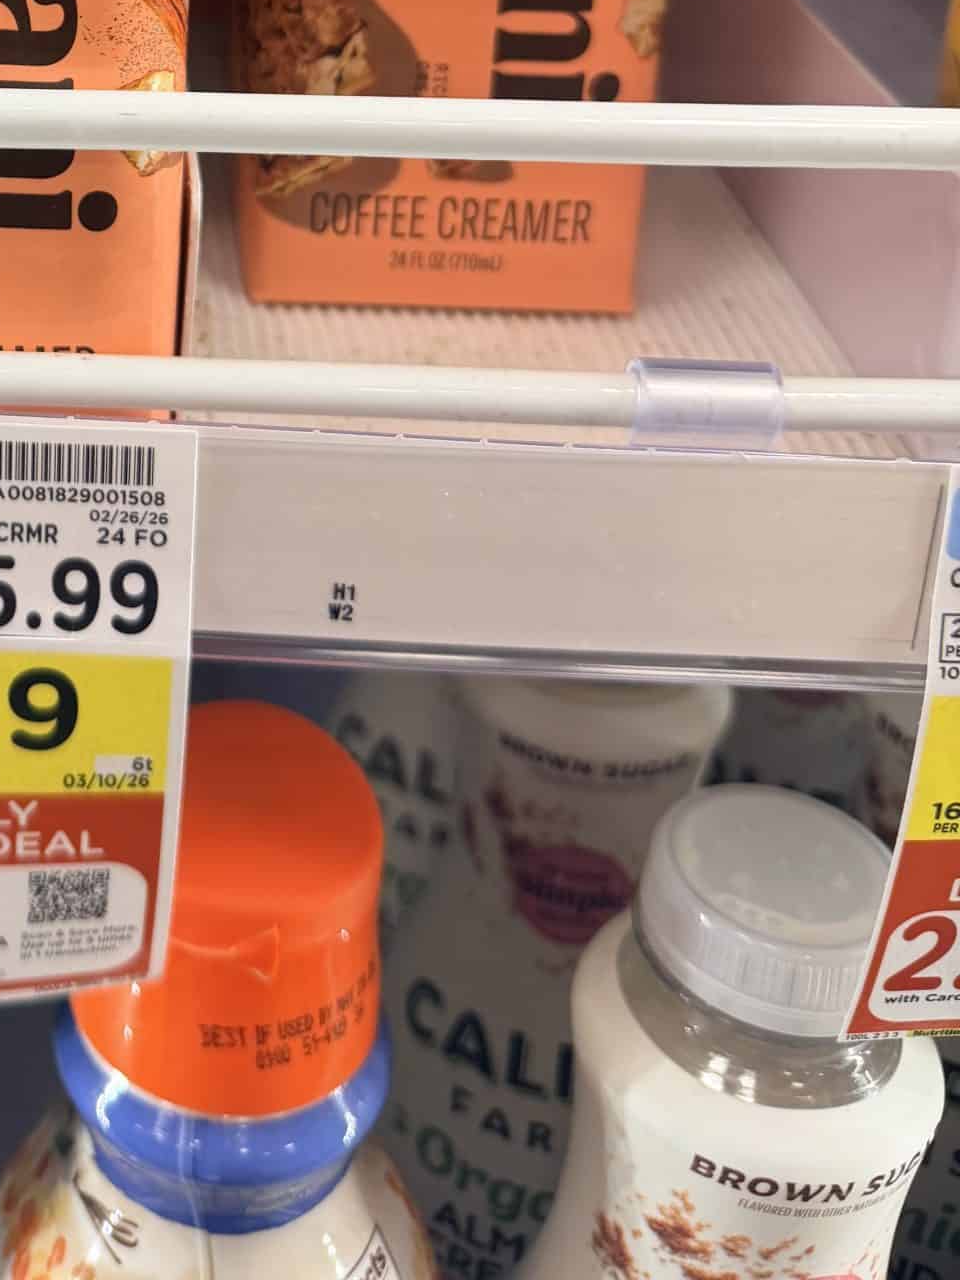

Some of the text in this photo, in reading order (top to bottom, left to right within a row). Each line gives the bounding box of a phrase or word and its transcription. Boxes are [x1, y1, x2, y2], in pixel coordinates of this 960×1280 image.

[309, 191, 592, 243] COFFEE CREAMER
[88, 508, 169, 526] 02/26/26
[96, 527, 168, 548] 24 FO
[332, 582, 356, 601] H1
[946, 645, 960, 658] PE
[62, 773, 151, 790] 03/10/26
[933, 822, 959, 833] PER
[884, 994, 921, 1004] with
[405, 976, 575, 1106] CALI
[450, 1083, 554, 1153] FAR
[690, 1152, 856, 1204] BROWN
[861, 1150, 923, 1197] SUG
